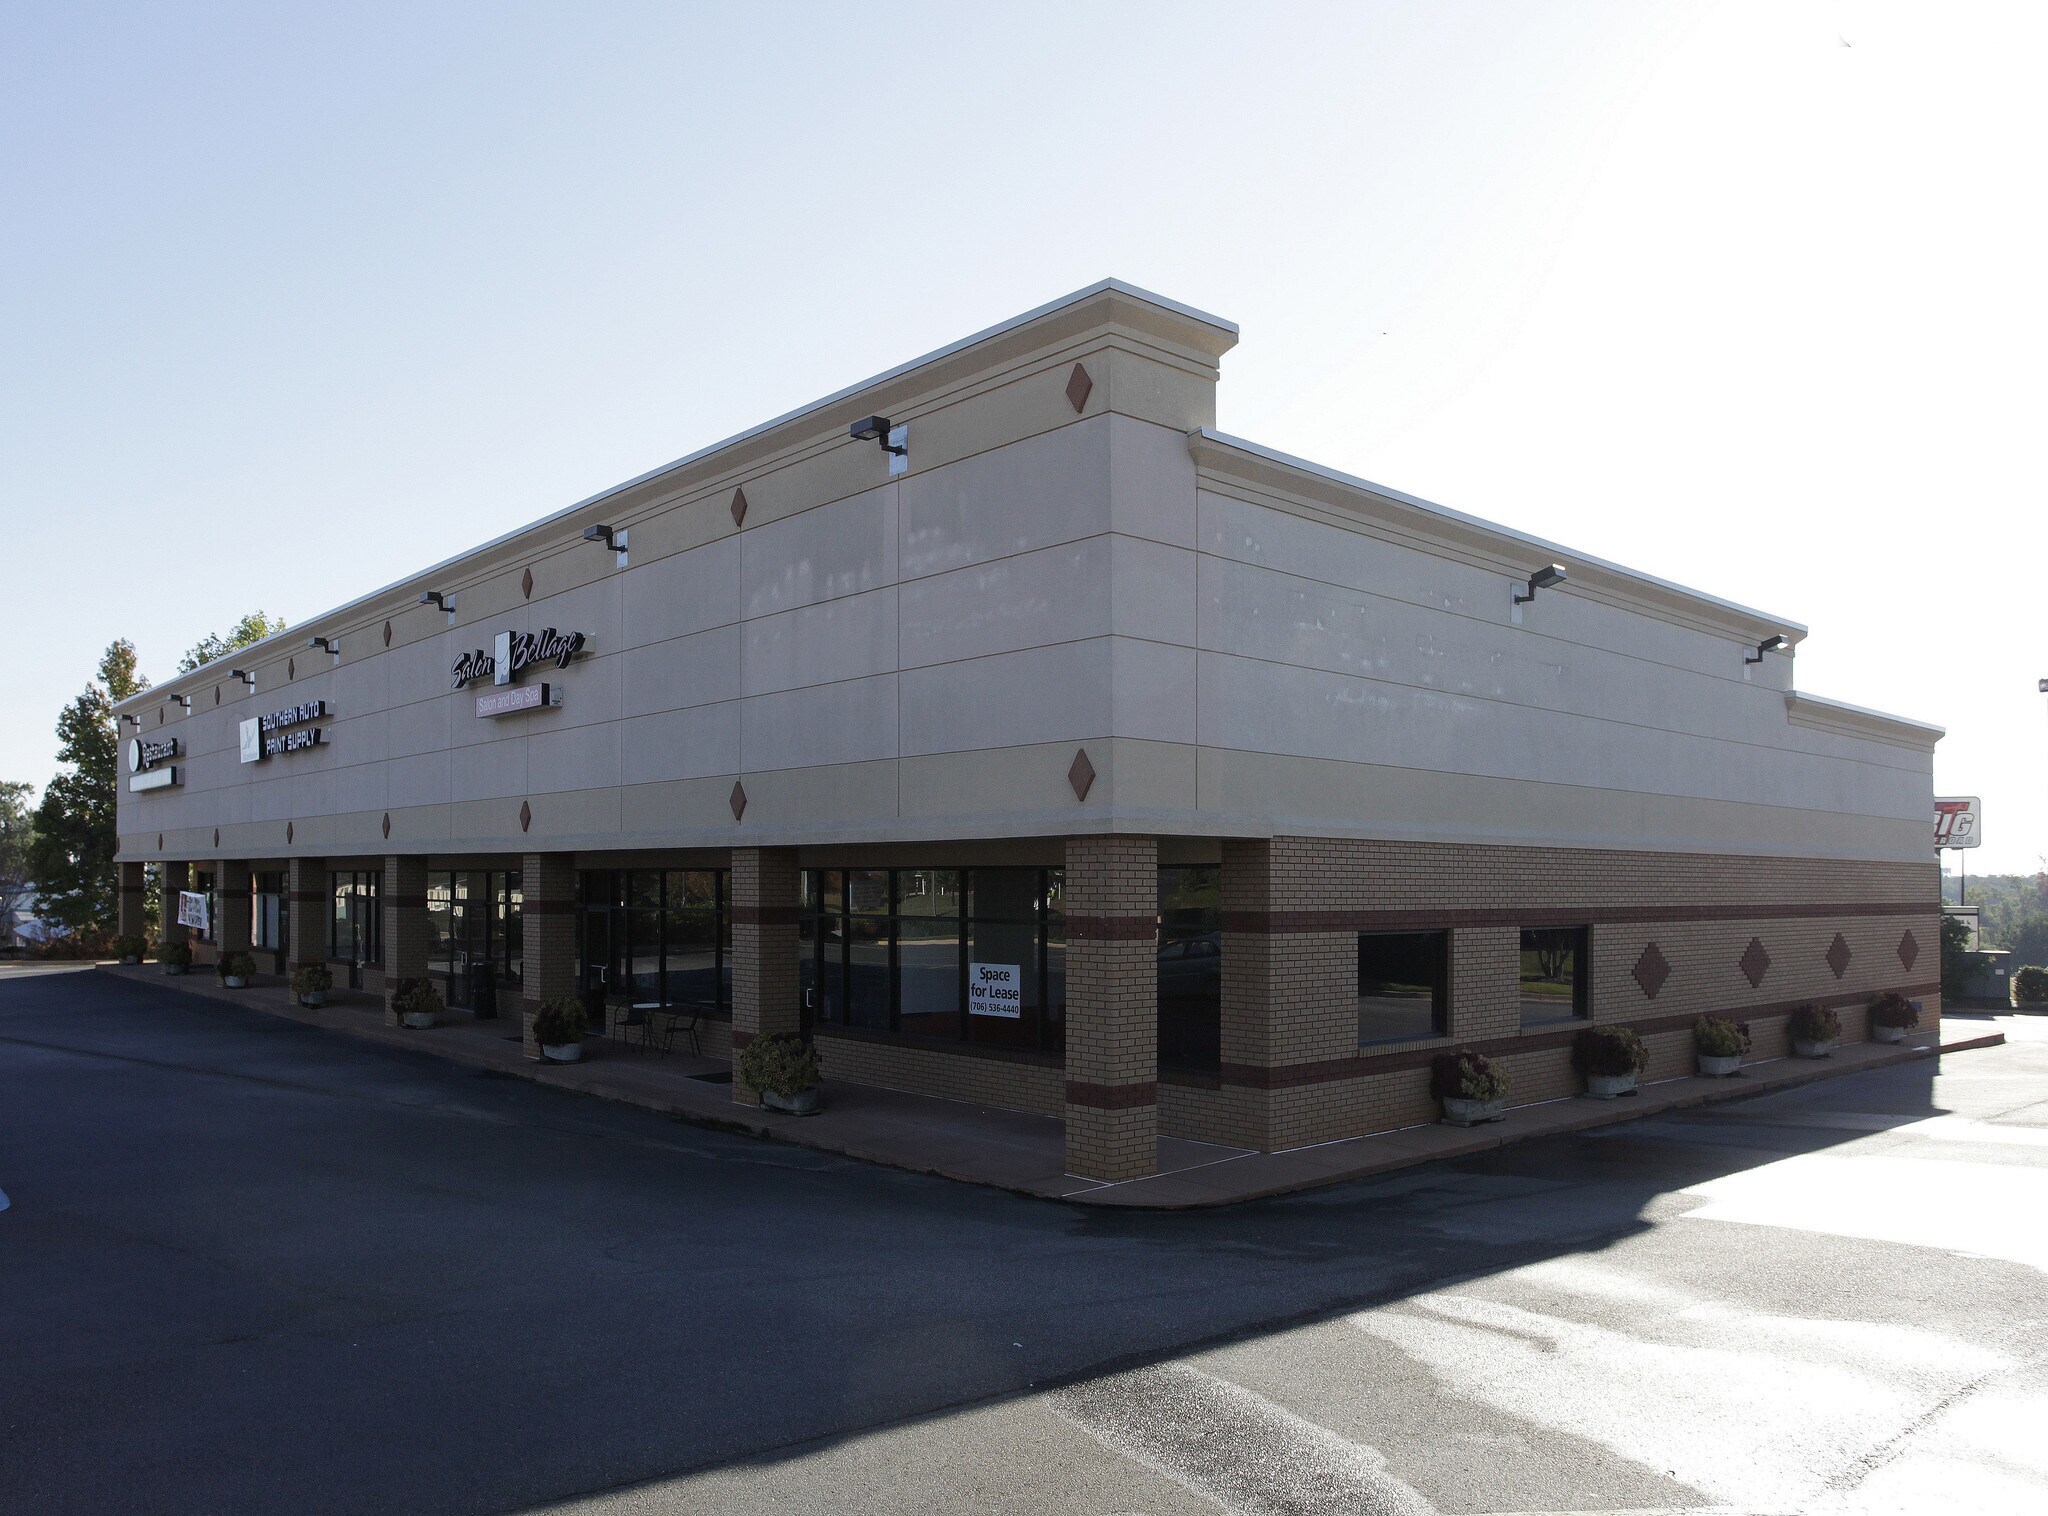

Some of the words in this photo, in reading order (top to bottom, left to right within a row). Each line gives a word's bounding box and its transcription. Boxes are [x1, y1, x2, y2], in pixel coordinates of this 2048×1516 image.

[451, 649, 494, 689] Salon
[511, 627, 580, 670] Bellage
[479, 697, 498, 713] Salon
[497, 695, 510, 709] and
[511, 691, 524, 707] Day
[525, 687, 539, 704] Spa
[262, 707, 298, 732] SOUTHERN
[300, 701, 320, 721] AUTO
[266, 736, 286, 755] PAINT
[287, 728, 316, 751] SUPPLY
[980, 967, 1010, 983] Space
[971, 983, 986, 997] for
[990, 985, 1019, 1000] Lease
[971, 1002, 986, 1012] (706)
[989, 1004, 1019, 1014] 536-4440
